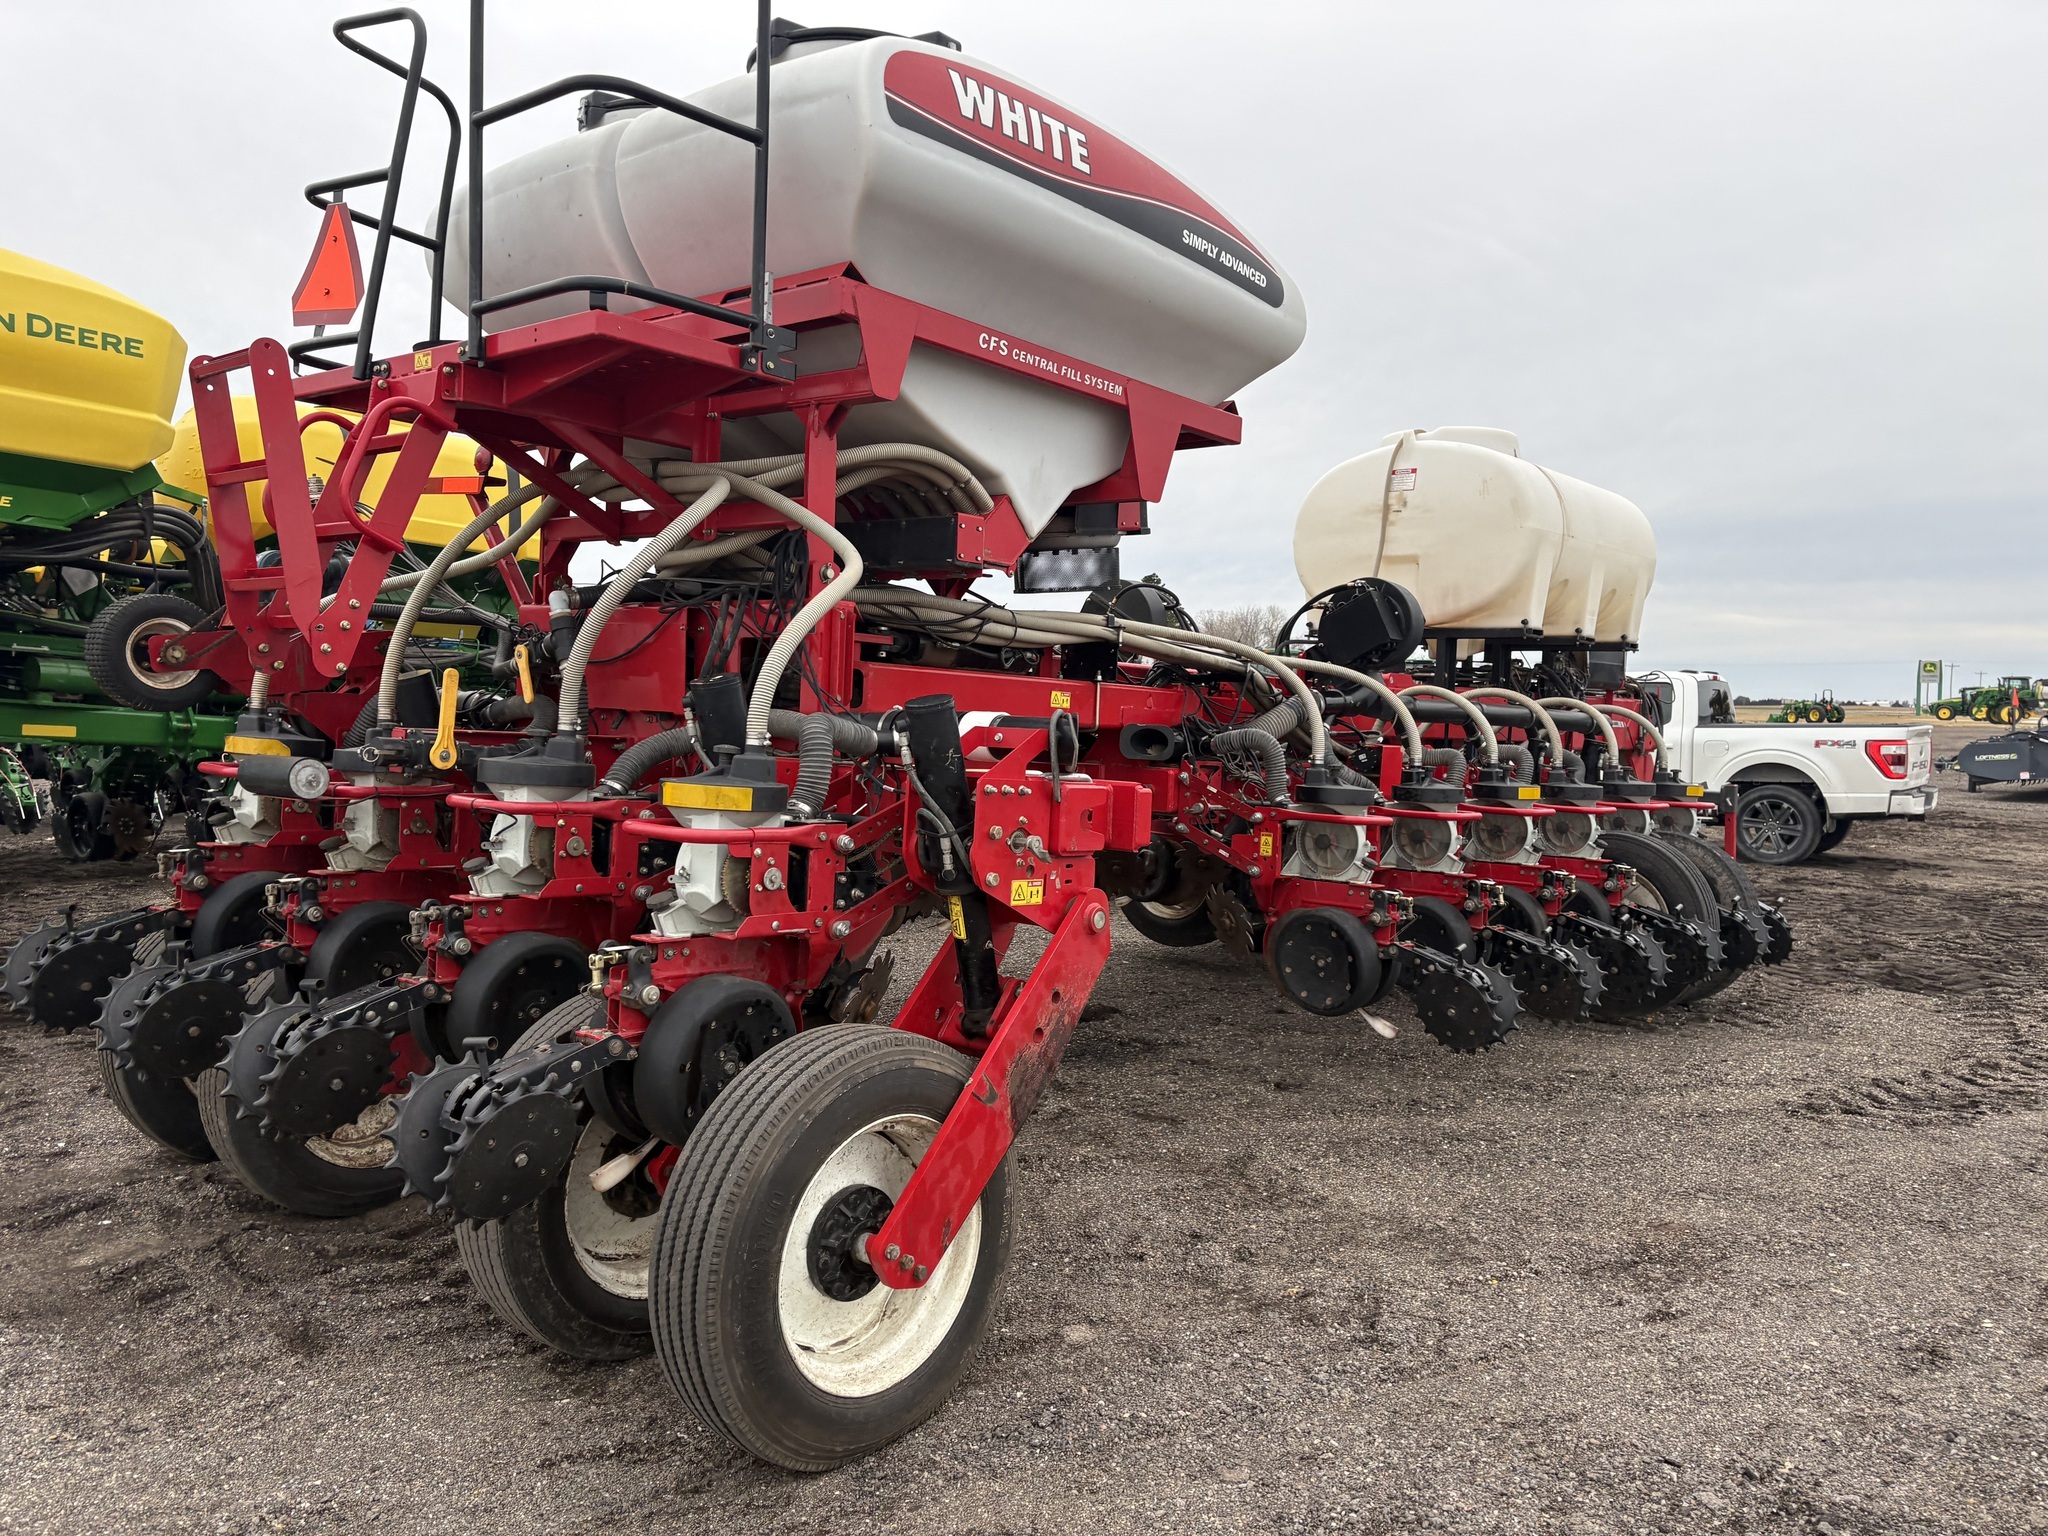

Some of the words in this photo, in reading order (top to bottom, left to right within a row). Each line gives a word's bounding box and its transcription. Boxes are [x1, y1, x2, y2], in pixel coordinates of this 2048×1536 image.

[946, 66, 1091, 177] WHITE
[1182, 229, 1219, 259] SIMPLY
[1219, 250, 1267, 288] ADVANCED
[26, 312, 144, 359] DEERE
[978, 332, 1009, 356] CFS
[1012, 348, 1059, 375] CENTRAL
[1061, 365, 1082, 383] FILL
[1084, 373, 1123, 396] SYSTEM
[1814, 739, 1857, 748] FX4
[1974, 753, 2010, 761] LOFTNESS
